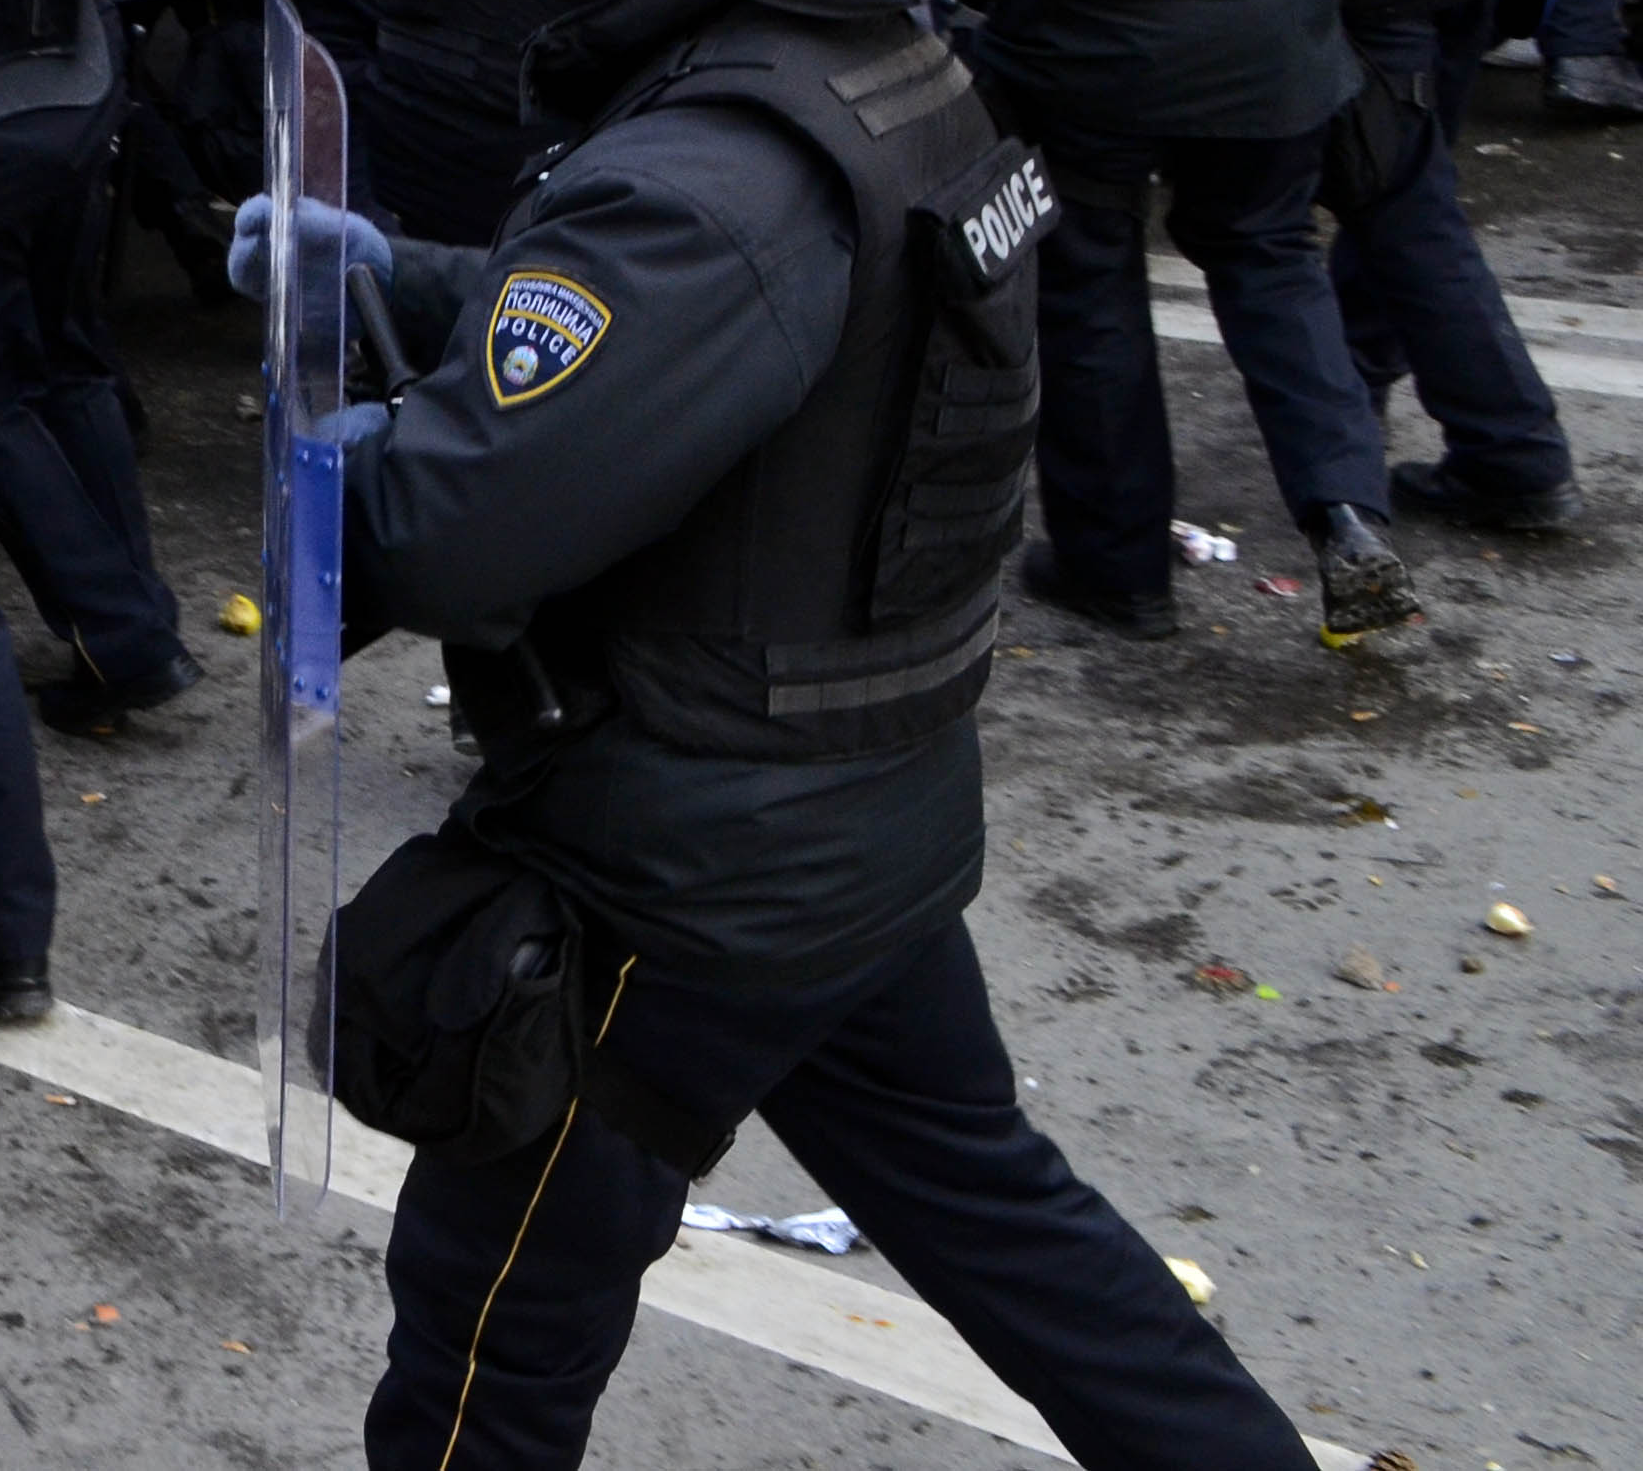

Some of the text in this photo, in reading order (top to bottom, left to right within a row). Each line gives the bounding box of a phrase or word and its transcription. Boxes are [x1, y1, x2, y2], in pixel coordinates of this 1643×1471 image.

[962, 157, 1054, 277] POLICE
[495, 316, 577, 367] POLICE
[504, 290, 594, 347] ПОЛИЦИЈА
